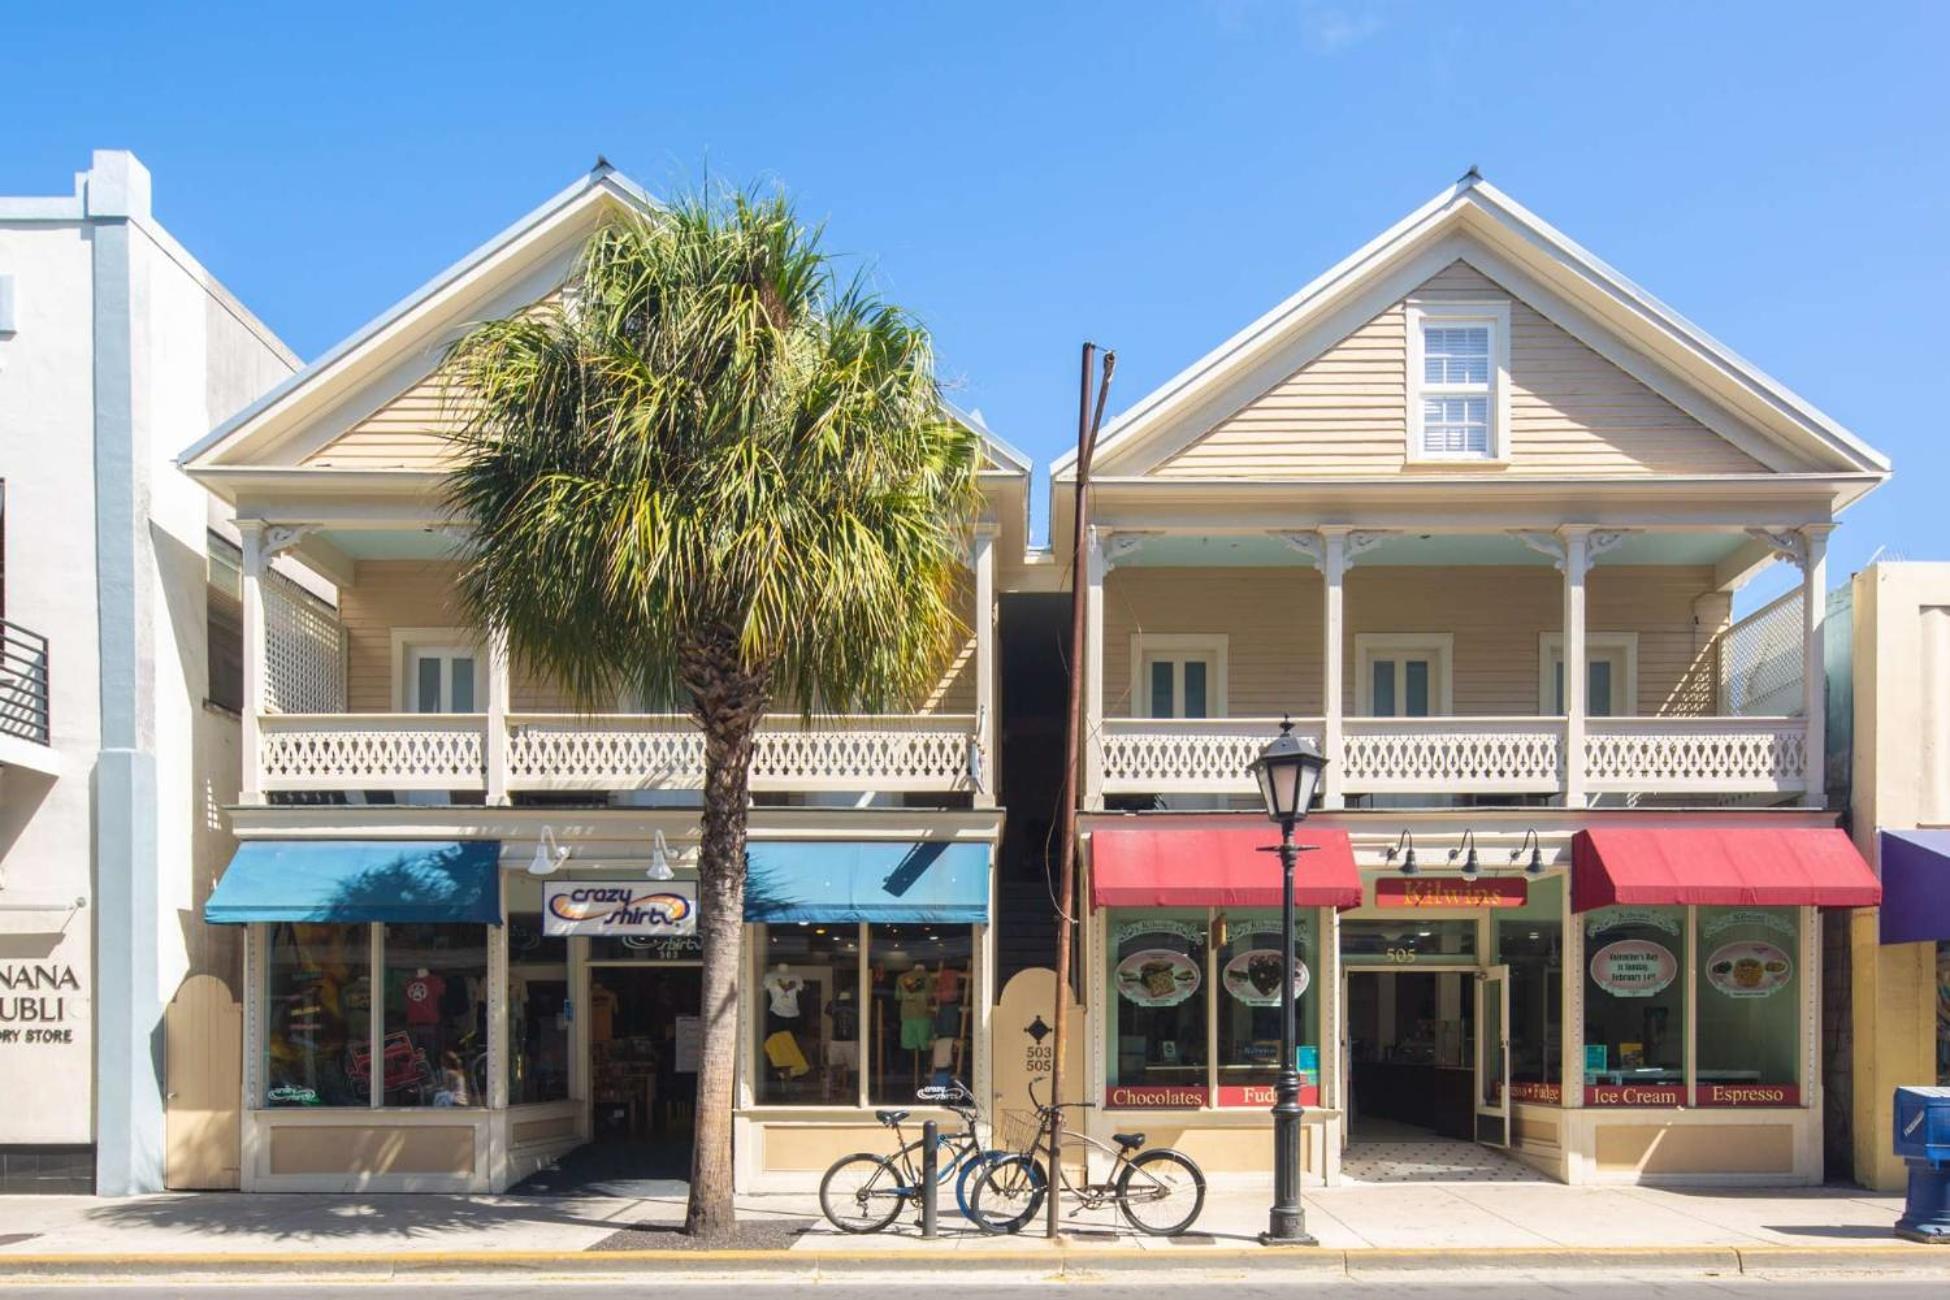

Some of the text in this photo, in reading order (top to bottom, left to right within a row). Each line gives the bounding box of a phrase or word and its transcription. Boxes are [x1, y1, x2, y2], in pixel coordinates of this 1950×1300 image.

[571, 888, 633, 906] crazy
[1403, 881, 1502, 905] Kilwins
[603, 907, 674, 926] shirts
[1386, 948, 1416, 963] 505
[0, 964, 80, 990] NANA
[0, 996, 64, 1022] UBLI
[0, 1029, 73, 1044] RY STORE
[1026, 1046, 1051, 1058] 503
[1026, 1059, 1051, 1071] 505
[1113, 1089, 1202, 1105] Chocolates
[1533, 1083, 1560, 1103] Fudge
[1594, 1088, 1676, 1104] Ice Cream
[1712, 1086, 1784, 1107] Espresso
